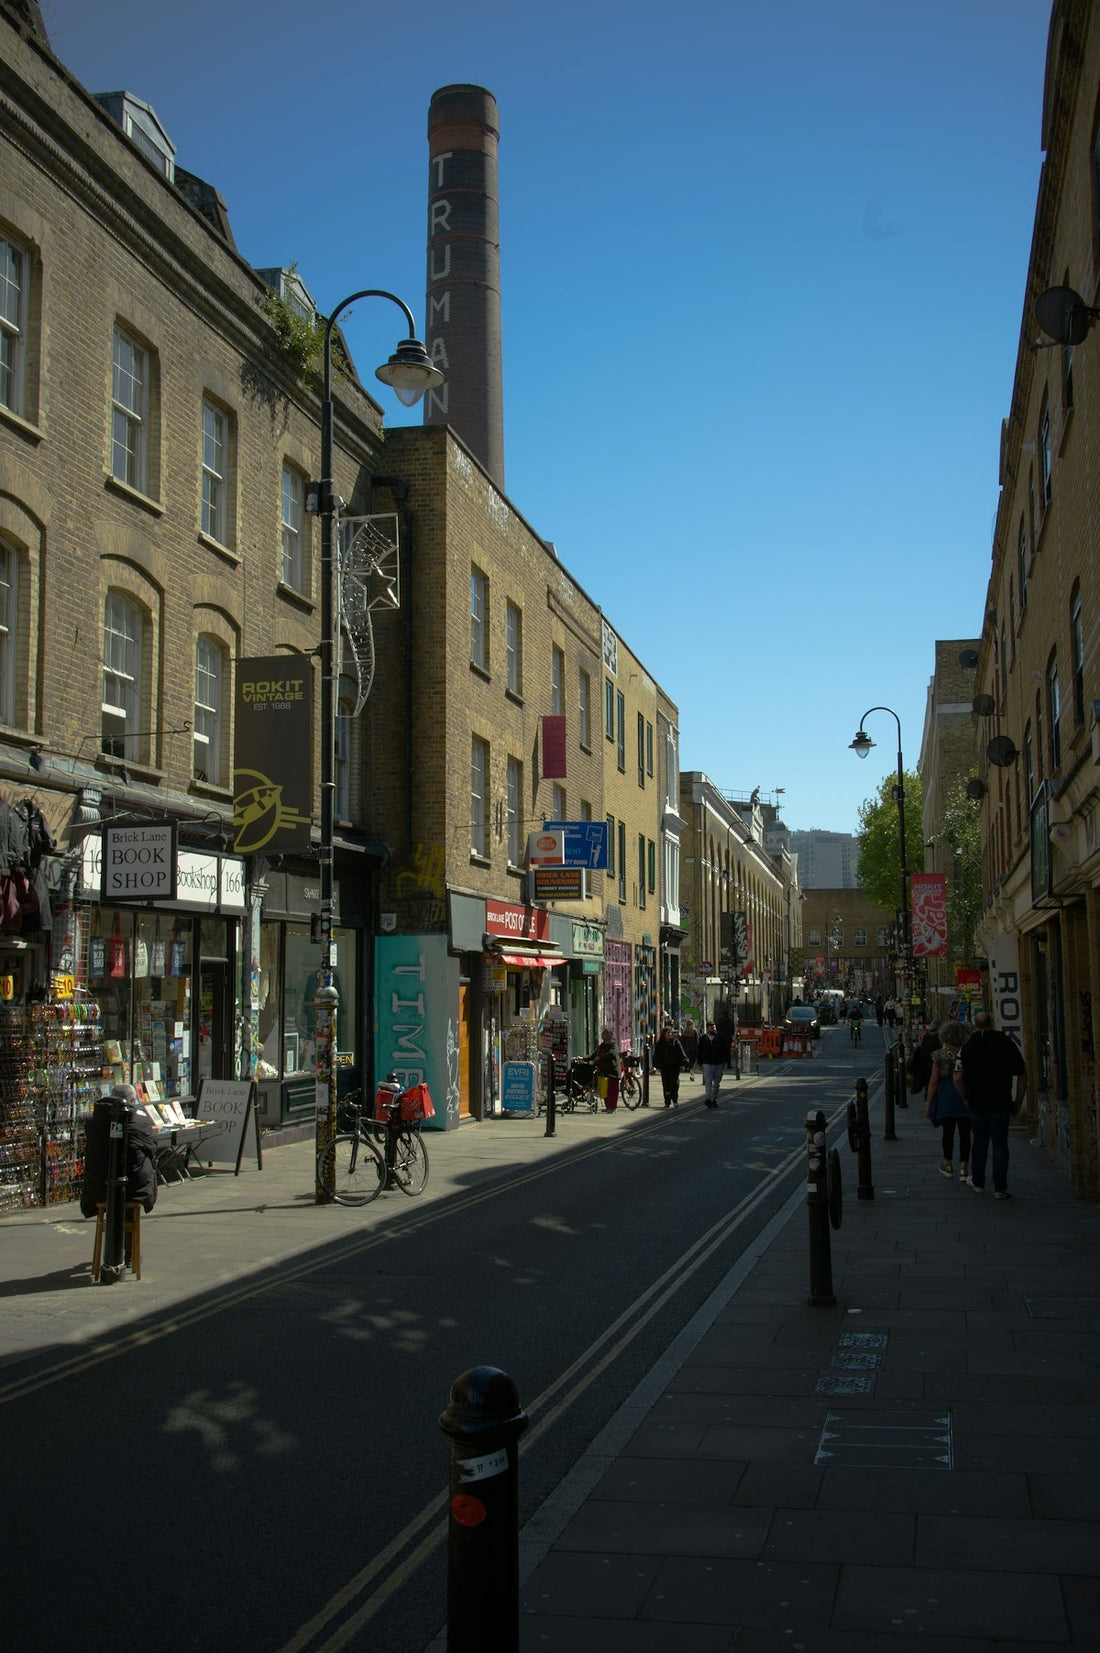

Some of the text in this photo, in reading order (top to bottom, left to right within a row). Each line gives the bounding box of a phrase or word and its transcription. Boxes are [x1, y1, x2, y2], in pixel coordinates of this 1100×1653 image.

[428, 152, 453, 418] TRUMAN
[242, 680, 303, 694] ROKIT
[242, 692, 303, 702] VINTAGE
[112, 831, 167, 844] Brick Lane
[112, 847, 165, 865] BOOK
[112, 871, 167, 889] SHOP
[177, 866, 217, 892] Bookshop
[225, 871, 241, 893] 166
[505, 911, 518, 930] POST
[0, 979, 11, 996] 10
[392, 953, 427, 1088] TIME
[336, 1055, 352, 1065] PEN
[508, 1067, 529, 1076] EVRI
[202, 1100, 243, 1114] BOOK
